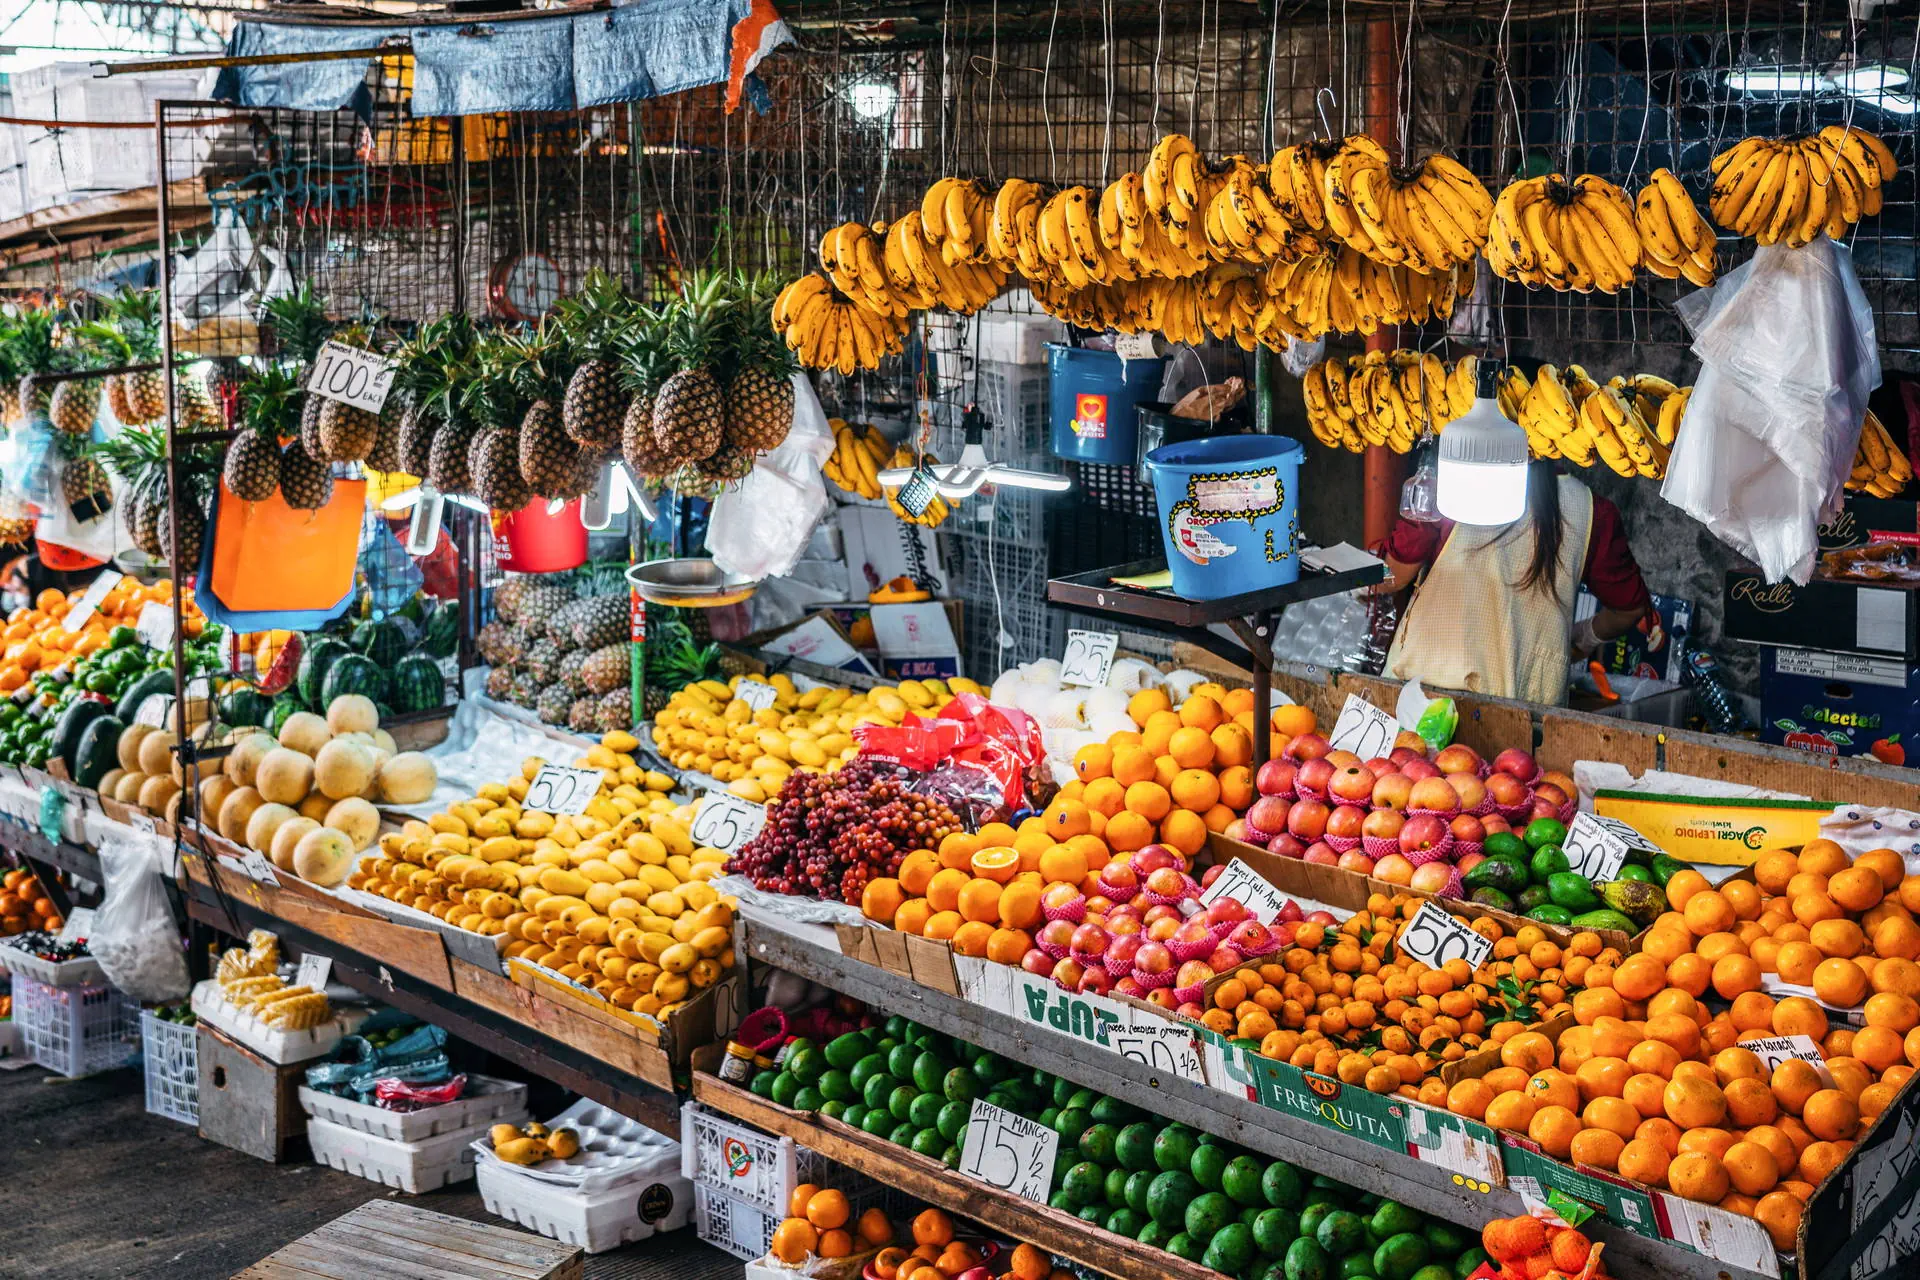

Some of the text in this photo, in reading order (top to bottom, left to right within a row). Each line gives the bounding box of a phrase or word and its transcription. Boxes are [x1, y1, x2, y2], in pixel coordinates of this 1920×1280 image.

[315, 355, 369, 399] 100
[1731, 577, 1795, 613] Ralli
[1063, 639, 1108, 681] 25
[1331, 707, 1387, 758] 20
[867, 754, 900, 764] SEEDLESS
[529, 771, 577, 810] 50
[694, 802, 748, 850] 65
[1675, 827, 1744, 841] AGRI LEPIDIO
[1566, 827, 1606, 881] 50
[1406, 911, 1468, 969] 50
[1023, 983, 1120, 1047] ZUPA
[974, 1102, 1050, 1144] APPLE MANGO
[1272, 1084, 1394, 1142] FRESQUITA
[967, 1118, 1020, 1190] 15
